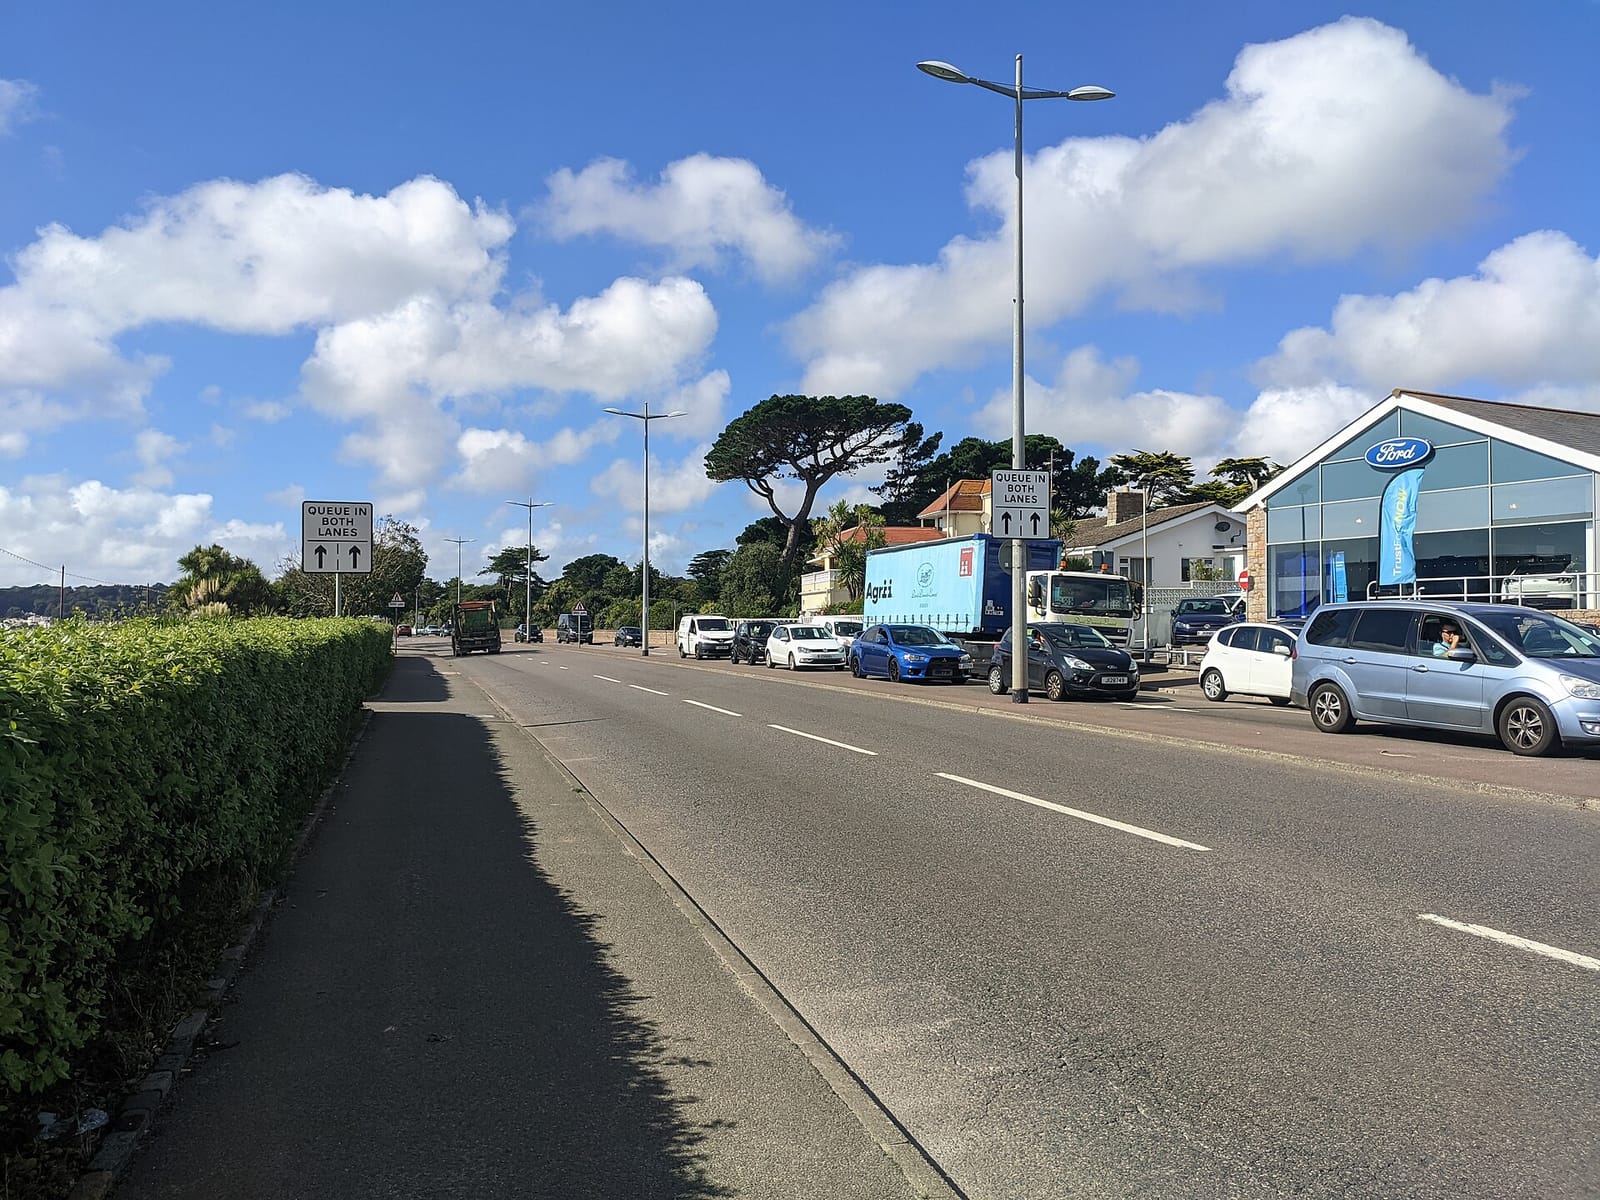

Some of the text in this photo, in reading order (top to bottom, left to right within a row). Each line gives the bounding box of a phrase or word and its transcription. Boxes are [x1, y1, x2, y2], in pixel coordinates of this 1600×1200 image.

[1376, 442, 1417, 464] Ford
[996, 473, 1046, 483] QUEUE IN
[1007, 484, 1034, 493] BOTH
[1004, 494, 1038, 504] LANES
[308, 506, 367, 516] QUEUE IN
[322, 517, 354, 526] BOTH
[318, 527, 358, 537] LANES
[866, 579, 893, 605] Agrii
